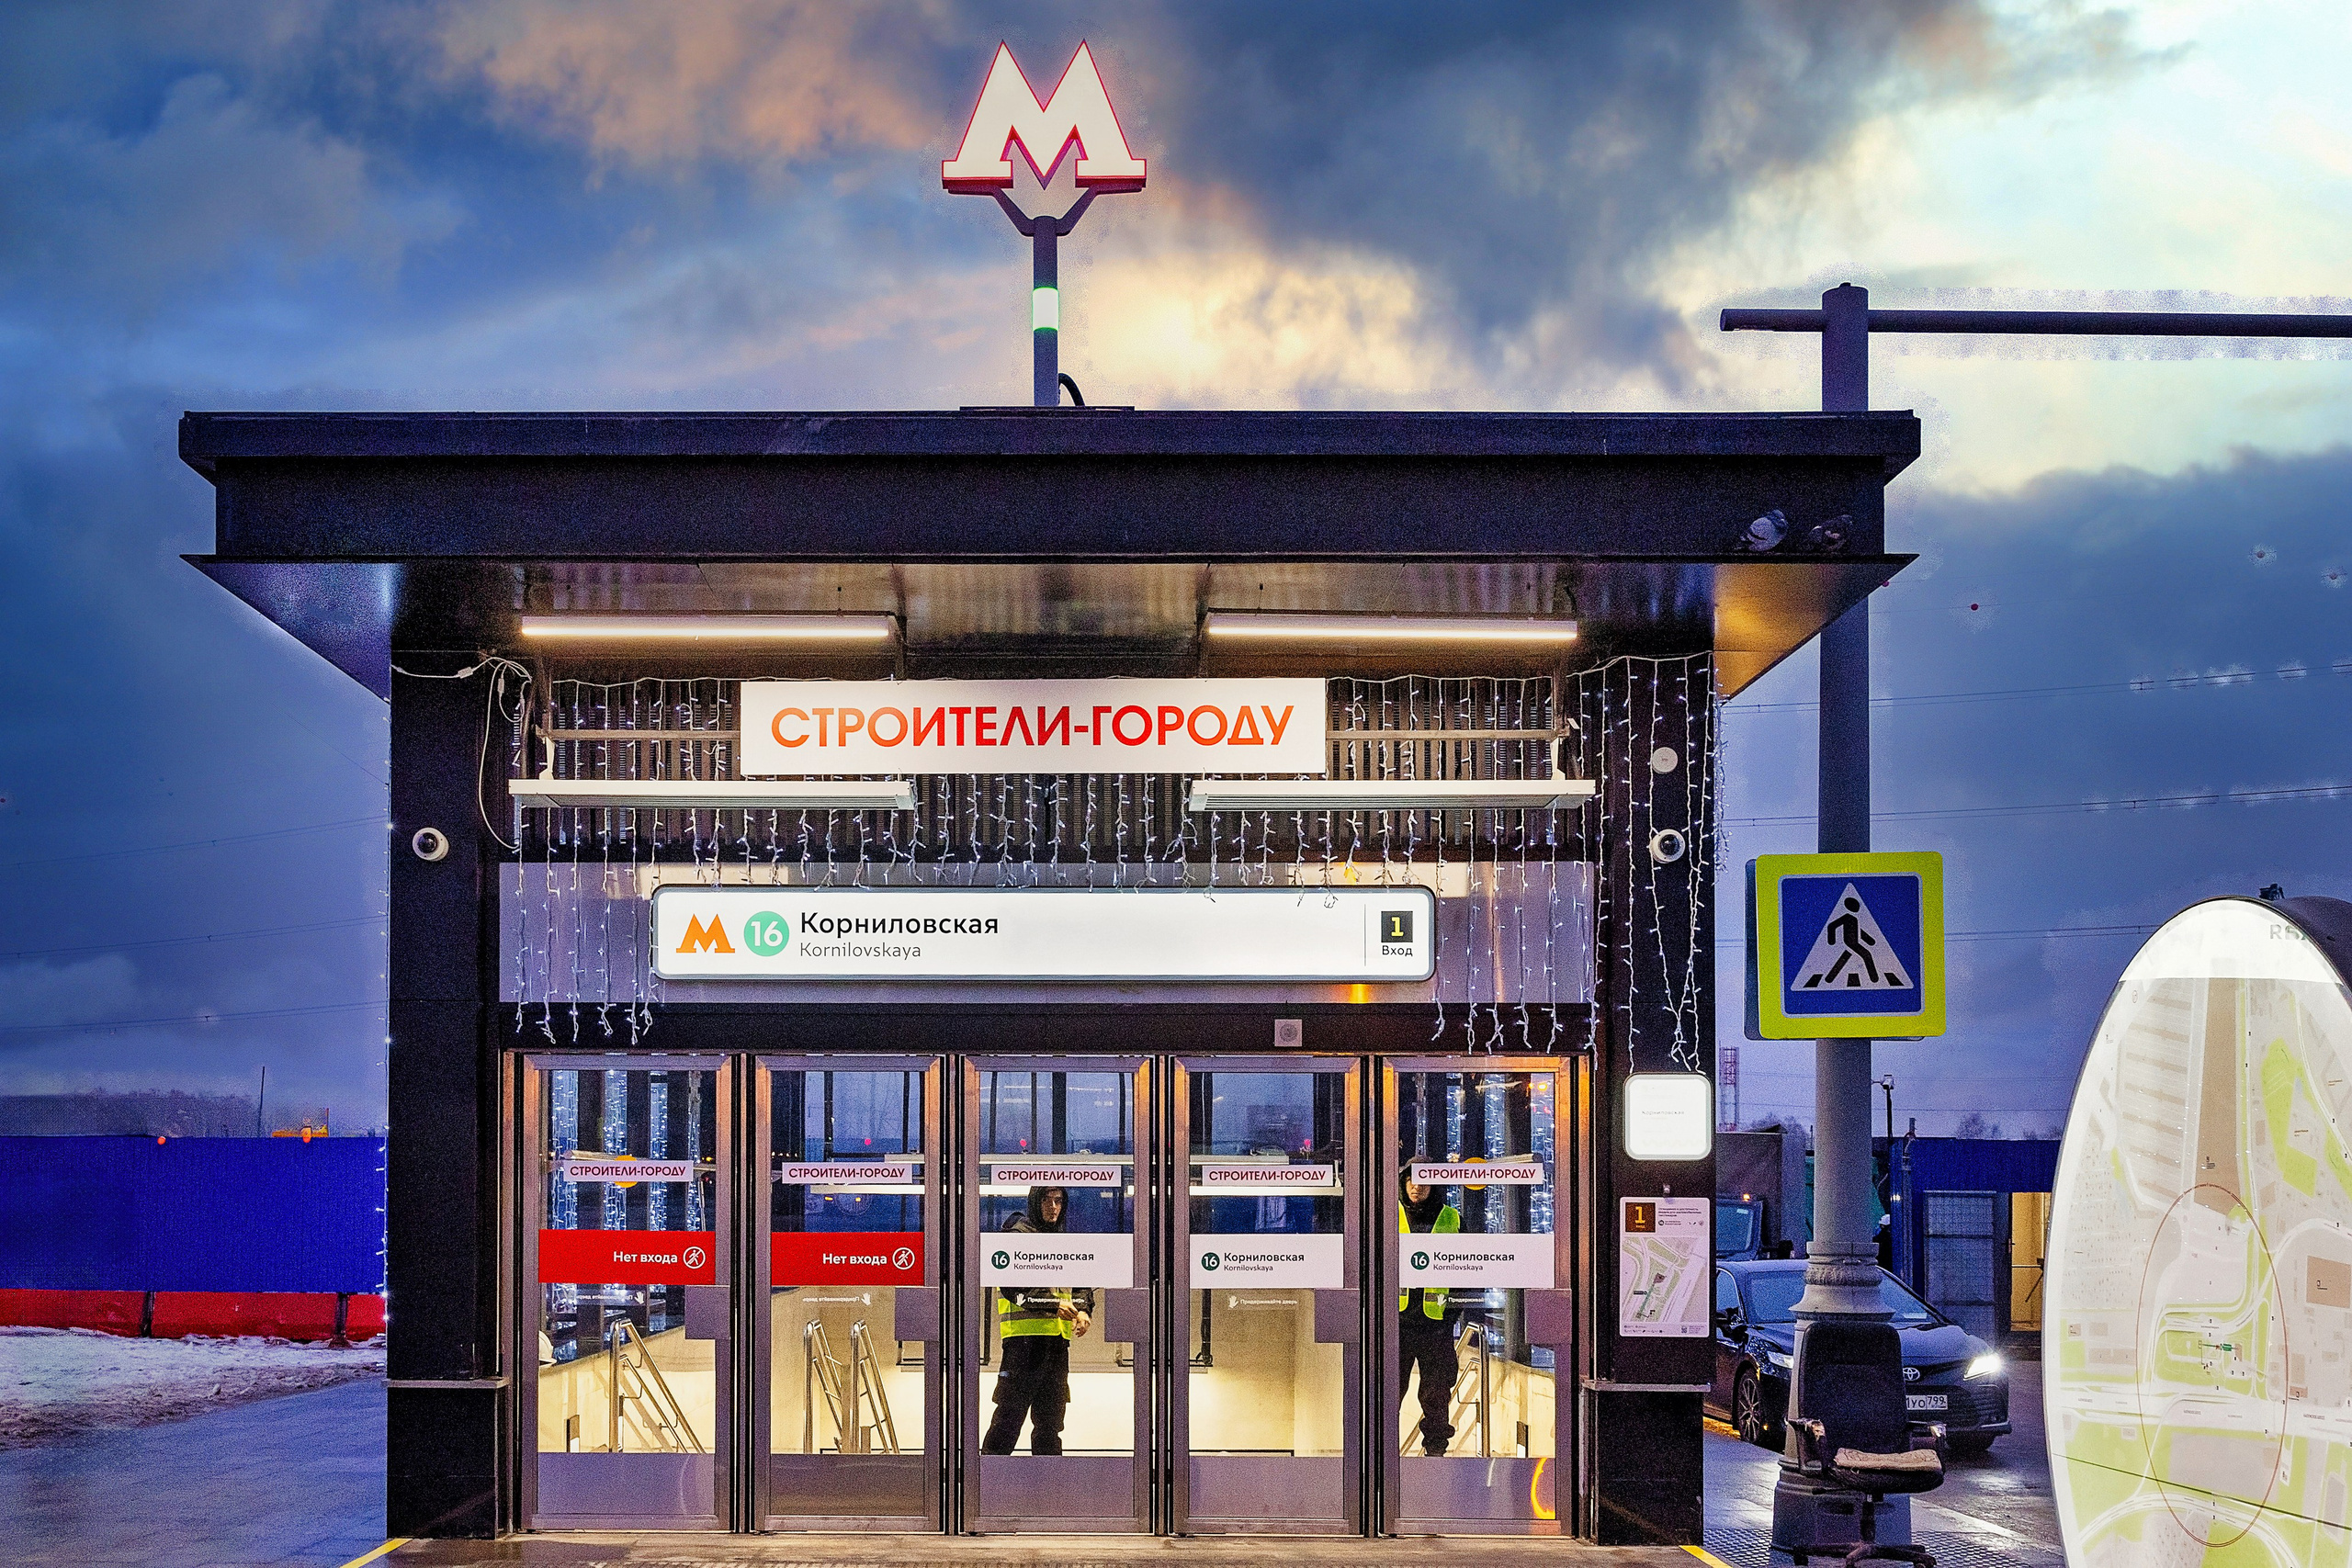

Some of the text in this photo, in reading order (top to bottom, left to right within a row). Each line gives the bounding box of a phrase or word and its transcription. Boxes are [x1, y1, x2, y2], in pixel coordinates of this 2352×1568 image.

[771, 705, 1295, 749] СТРОИТЕЛИ-ГОРОДУ
[800, 912, 999, 939] Корниловская
[1391, 917, 1404, 937] 1
[751, 920, 783, 947] 16
[800, 942, 921, 961] Kornilovskaya
[1382, 945, 1413, 957] Вход
[570, 1166, 686, 1178] СТРОИТЕЛИ-ГОРОДУ
[788, 1168, 905, 1179] СТРОИТЕЛИ-ГОРОДУ
[997, 1170, 1114, 1181] СТРОИТЕЛИ-ГОРОДУ
[1208, 1170, 1326, 1181] СТРОИТЕЛИ-ГОРОДУ
[1418, 1168, 1536, 1179] СТРОИТЕЛИ-ГОРОДУ
[1635, 1206, 1645, 1224] 1
[613, 1251, 678, 1265] Нет входа
[822, 1253, 888, 1266] Нет входа
[994, 1254, 1008, 1266] 16
[1013, 1251, 1094, 1262] Корниловская
[1204, 1256, 1218, 1268] 16
[1224, 1252, 1305, 1263] Корниловская
[1413, 1255, 1427, 1267] 16
[1433, 1251, 1515, 1262] Корниловская
[1013, 1263, 1063, 1271] Kornilovskaya
[1927, 1395, 1945, 1405] 799
